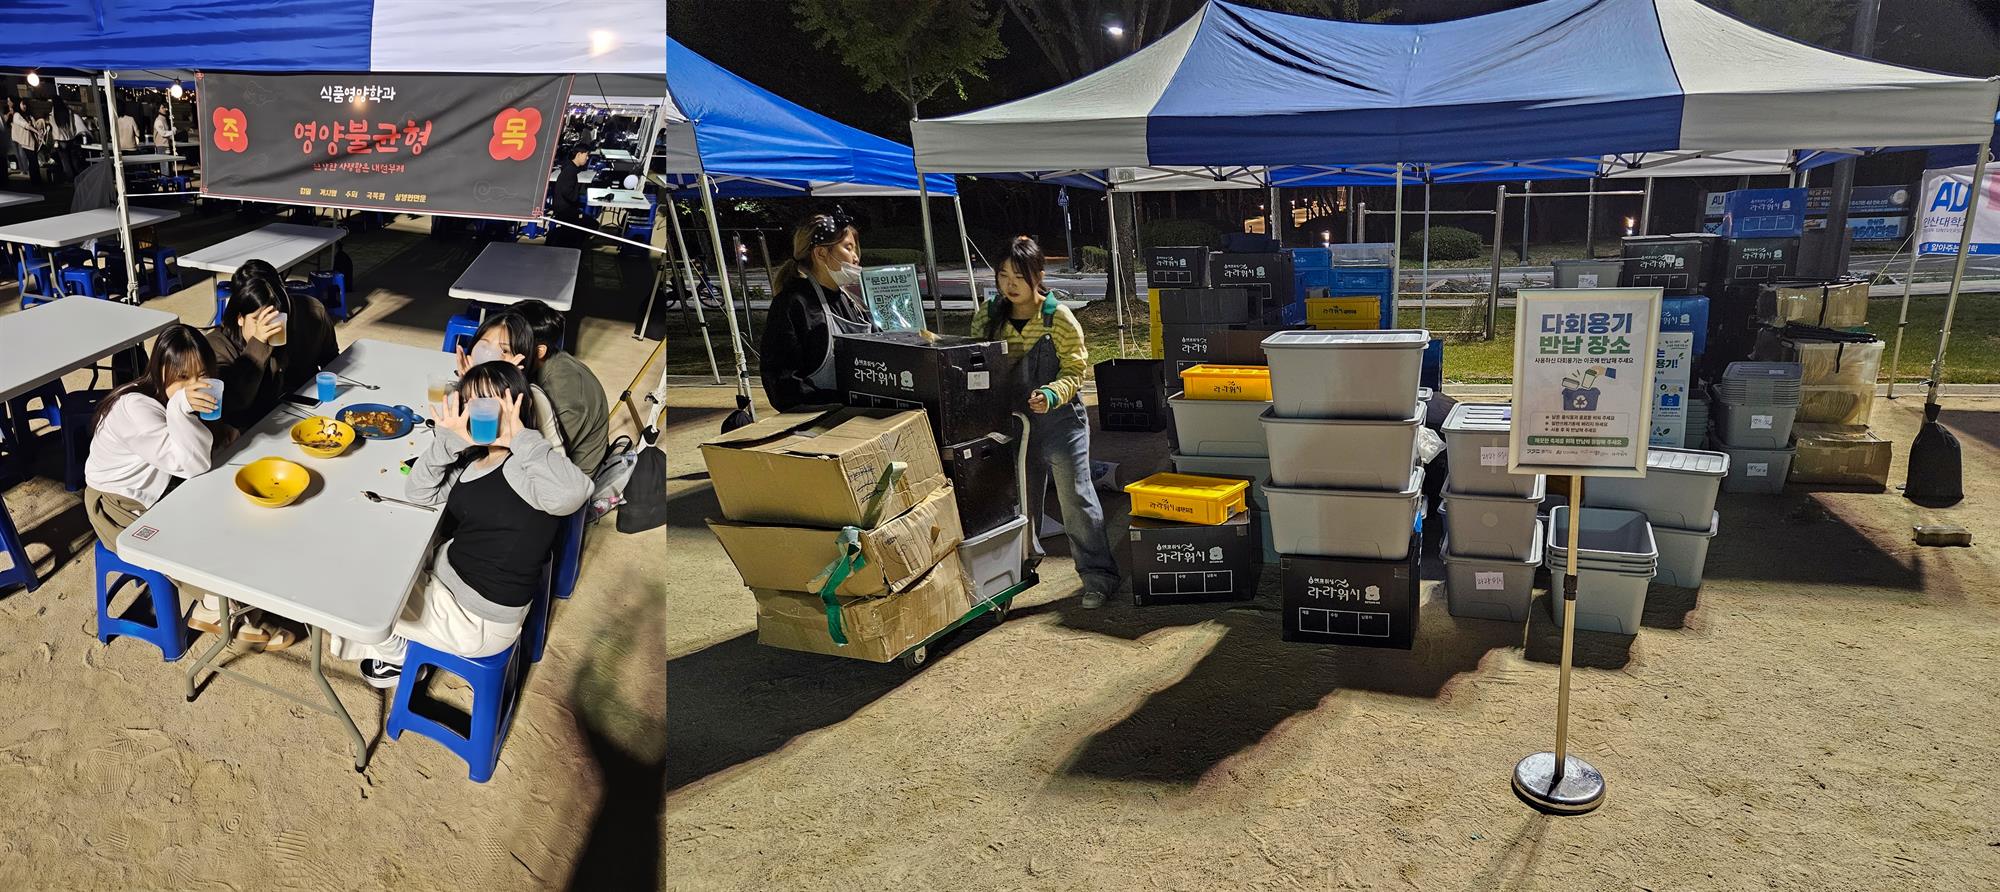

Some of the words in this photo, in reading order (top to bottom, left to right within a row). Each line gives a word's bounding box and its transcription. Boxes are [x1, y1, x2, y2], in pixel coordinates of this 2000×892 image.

[320, 84, 396, 103] 식품영양학과
[222, 117, 239, 142] 주
[294, 118, 433, 156] 영양불균형
[502, 117, 527, 151] 목
[1930, 181, 1973, 213] AU
[1541, 312, 1633, 335] 다회용기
[1539, 335, 1584, 355] 반납
[1587, 335, 1631, 355] 장소
[854, 368, 897, 387] 라라워시
[1156, 551, 1205, 564] 라라워시
[1307, 586, 1361, 602] 라라워시
